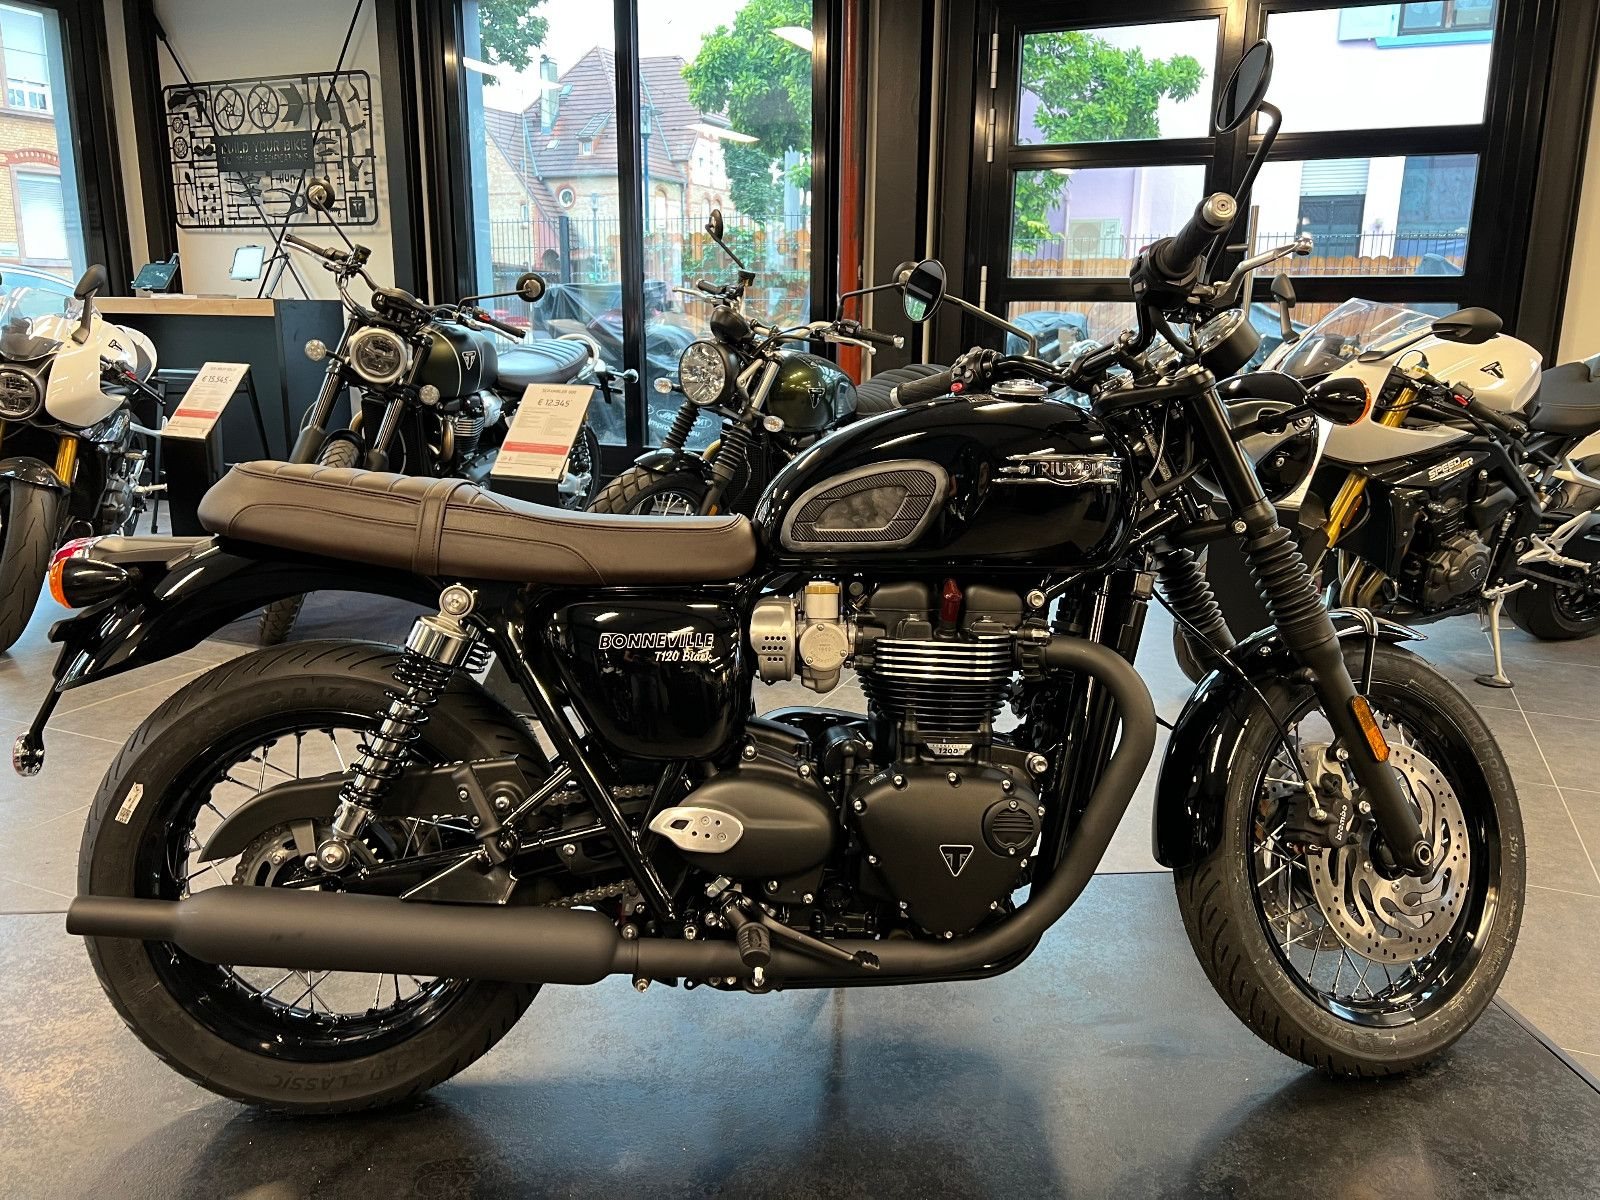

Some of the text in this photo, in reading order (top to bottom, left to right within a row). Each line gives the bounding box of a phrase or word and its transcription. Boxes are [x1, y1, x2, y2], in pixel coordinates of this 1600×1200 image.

[252, 139, 280, 153] YOUR
[283, 138, 308, 152] BIKE
[1028, 460, 1104, 476] TRIUMPH
[1428, 456, 1461, 478] SPEED
[598, 632, 715, 650] BONNEVILLE
[654, 649, 713, 662] T120 Black
[1335, 804, 1348, 841] brembo
